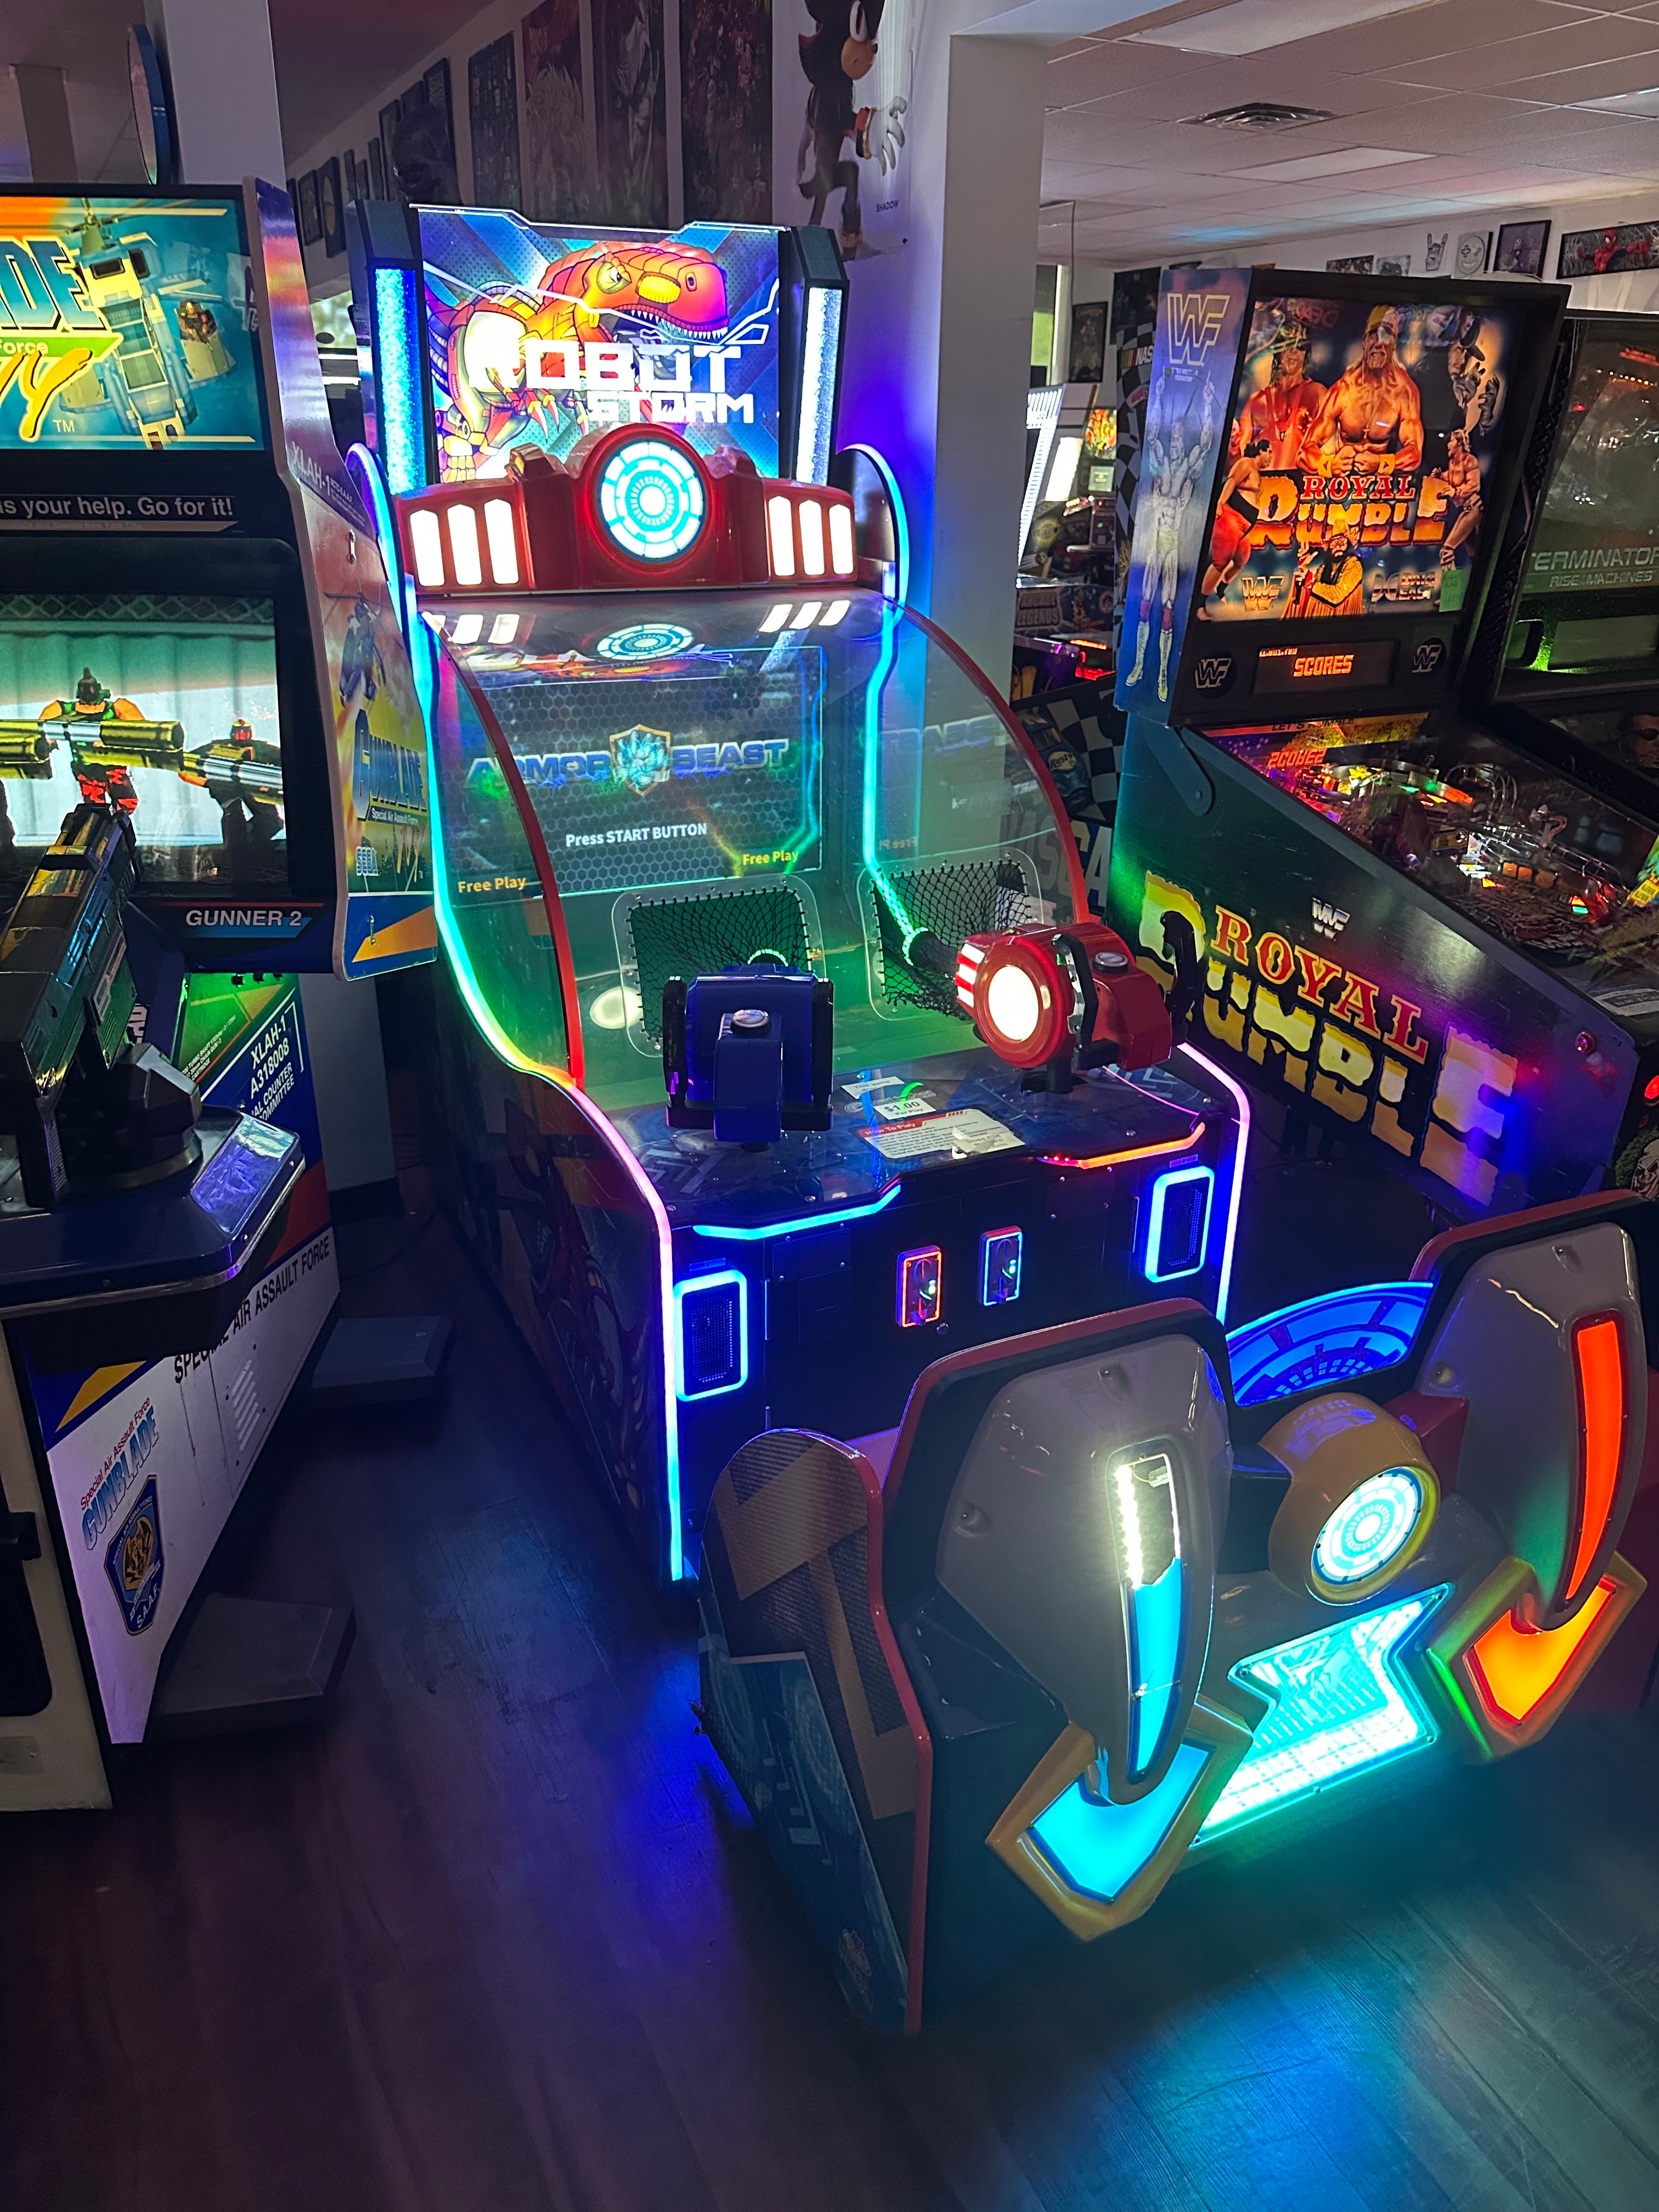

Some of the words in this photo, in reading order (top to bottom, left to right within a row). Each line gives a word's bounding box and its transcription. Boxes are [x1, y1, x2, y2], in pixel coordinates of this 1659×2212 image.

[876, 199, 899, 212] SHADOW
[0, 239, 108, 331] DE
[0, 341, 49, 355] orce
[1135, 345, 1154, 365] NAS
[468, 336, 742, 393] ROBOT
[587, 391, 754, 424] STORM
[53, 420, 75, 432] TM
[291, 440, 331, 496] XLAH-1
[1299, 475, 1417, 500] ROYAL
[21, 500, 71, 519] your
[77, 496, 132, 520] help.
[137, 496, 170, 516] Go
[174, 496, 205, 515] for
[211, 497, 233, 516] it!
[1249, 475, 1449, 550] RUMBLE
[1531, 547, 1659, 571] ERMINATOR
[1400, 571, 1436, 586] DATA
[1549, 574, 1581, 588] RISE
[1586, 571, 1654, 585] MACHINES
[1398, 586, 1432, 601] EAST
[1293, 654, 1354, 677] SCORES
[670, 738, 789, 772] BEAST
[1050, 753, 1074, 769] Rusty
[565, 832, 604, 847] Press
[606, 827, 650, 843] START
[652, 823, 708, 840] BUTTON
[356, 847, 379, 876] SEGA
[742, 853, 770, 866] Free
[772, 850, 799, 865] Play
[457, 878, 492, 893] Free
[495, 876, 526, 890] Play
[185, 910, 283, 926] GUNNER
[289, 910, 302, 926] 2
[1209, 904, 1429, 1065] ROYAL
[250, 1015, 286, 1070] XLAH-1
[250, 1037, 290, 1099] A318008
[263, 1062, 292, 1104] COUNTER
[884, 1101, 921, 1112] $1.00
[864, 1127, 884, 1136] How
[897, 1122, 916, 1130] Play
[966, 1136, 986, 1144] Does
[174, 1334, 229, 1384] SPEC
[233, 1299, 251, 1335] AIR
[255, 1261, 298, 1316] ASSAULT
[301, 1235, 330, 1276] FORCE
[80, 1468, 104, 1510] Special
[104, 1454, 113, 1475] Air
[112, 1419, 134, 1459] Assault
[133, 1397, 150, 1426] Force
[82, 1405, 159, 1550] GUNBLADE
